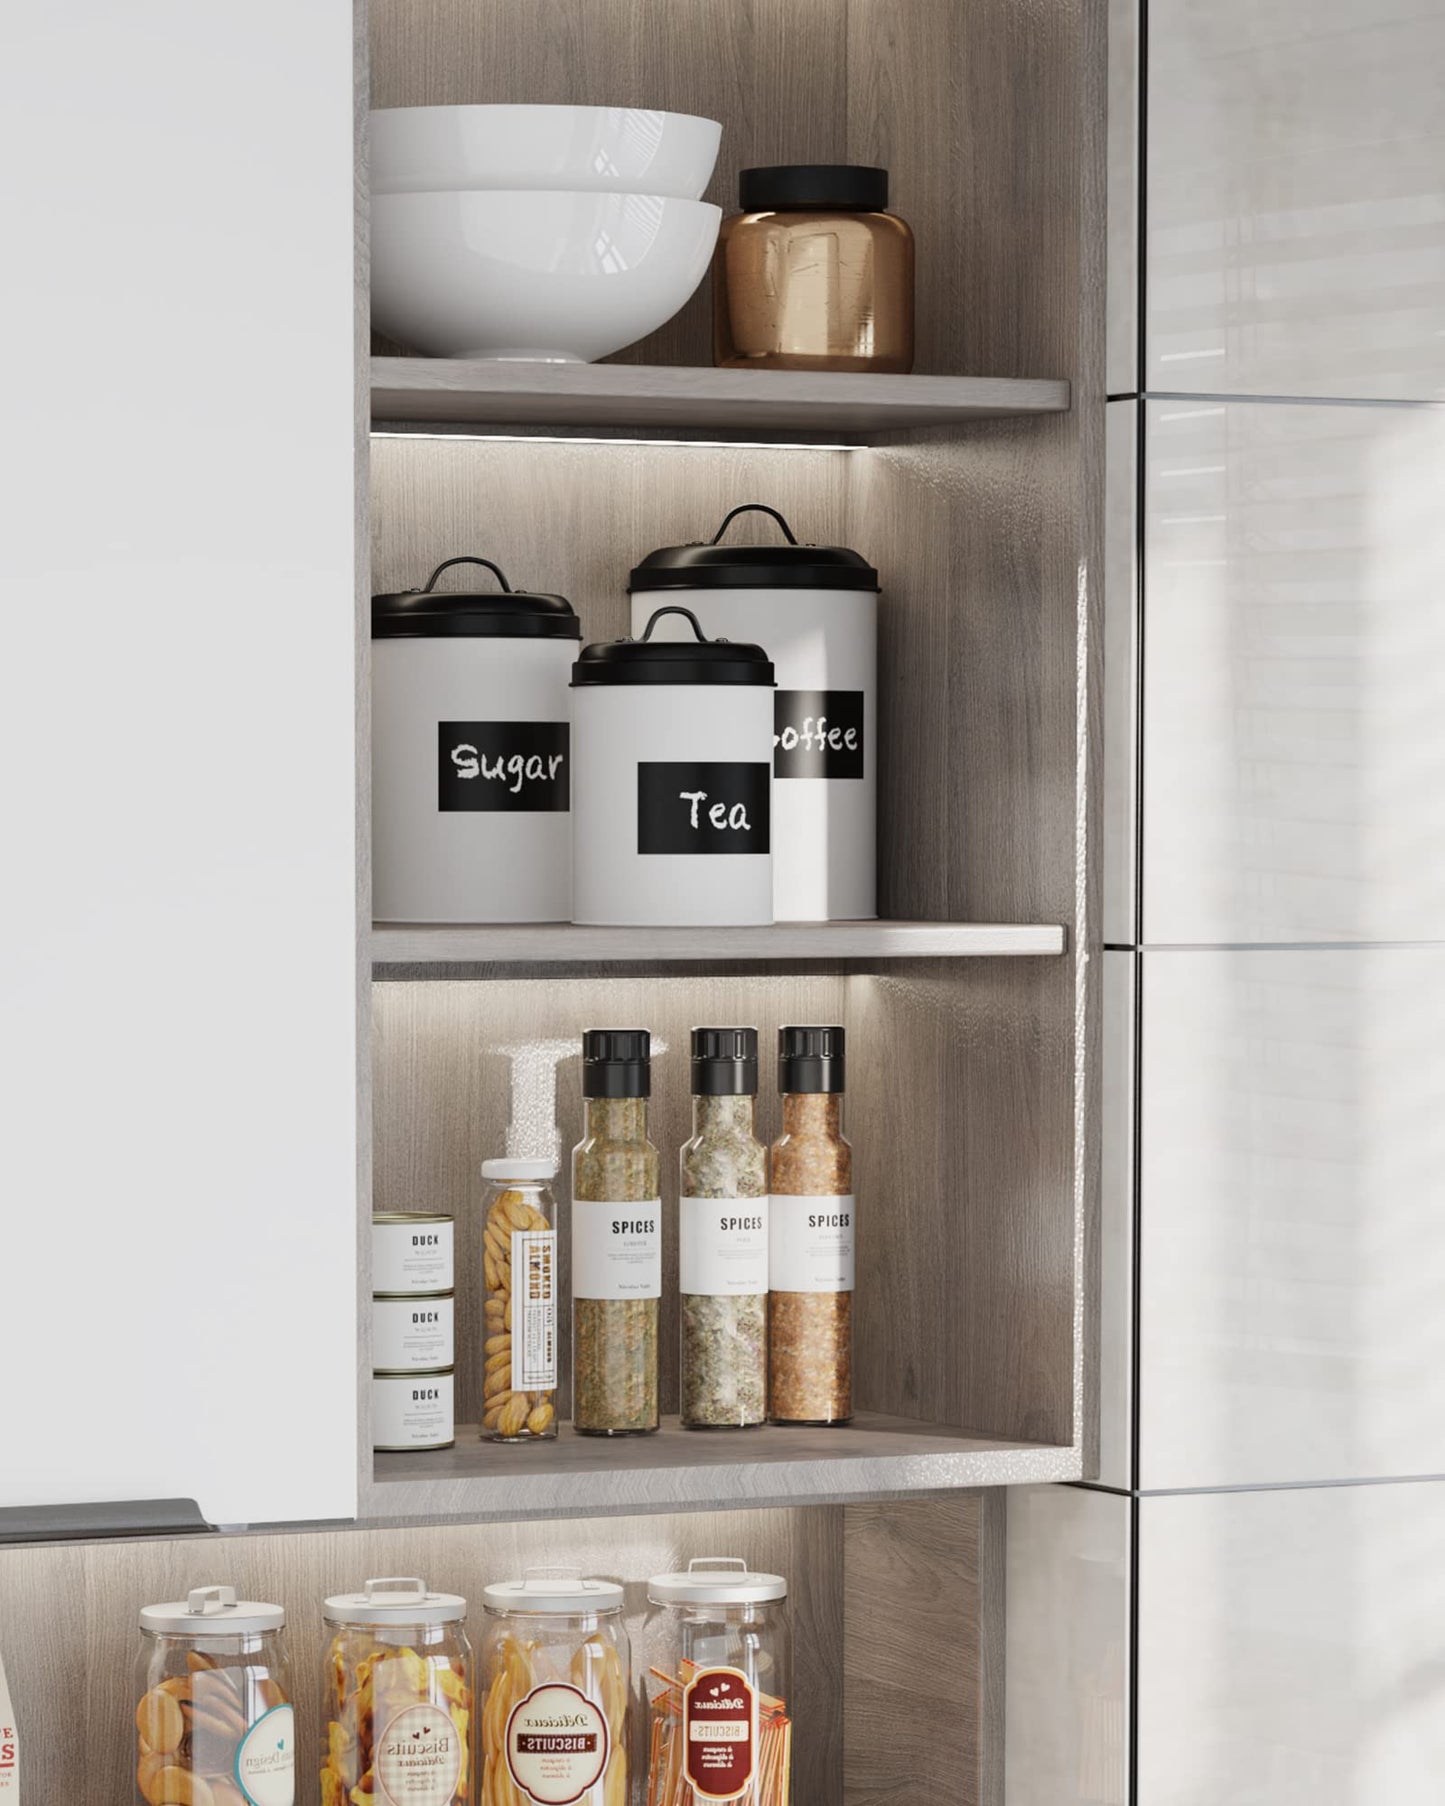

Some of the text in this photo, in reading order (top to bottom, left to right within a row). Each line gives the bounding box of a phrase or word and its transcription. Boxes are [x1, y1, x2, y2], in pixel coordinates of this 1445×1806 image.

[774, 716, 858, 751] offee
[450, 743, 564, 793] Sugar
[679, 790, 752, 831] Tea
[612, 1220, 655, 1234] SPICES
[720, 1216, 763, 1231] SPICES
[808, 1213, 850, 1228] SPICES
[412, 1234, 439, 1246] DUCK
[529, 1245, 541, 1299] ALMOND
[542, 1245, 551, 1299] SMOKED
[412, 1312, 439, 1323] DUCK
[412, 1389, 439, 1401] DUCK
